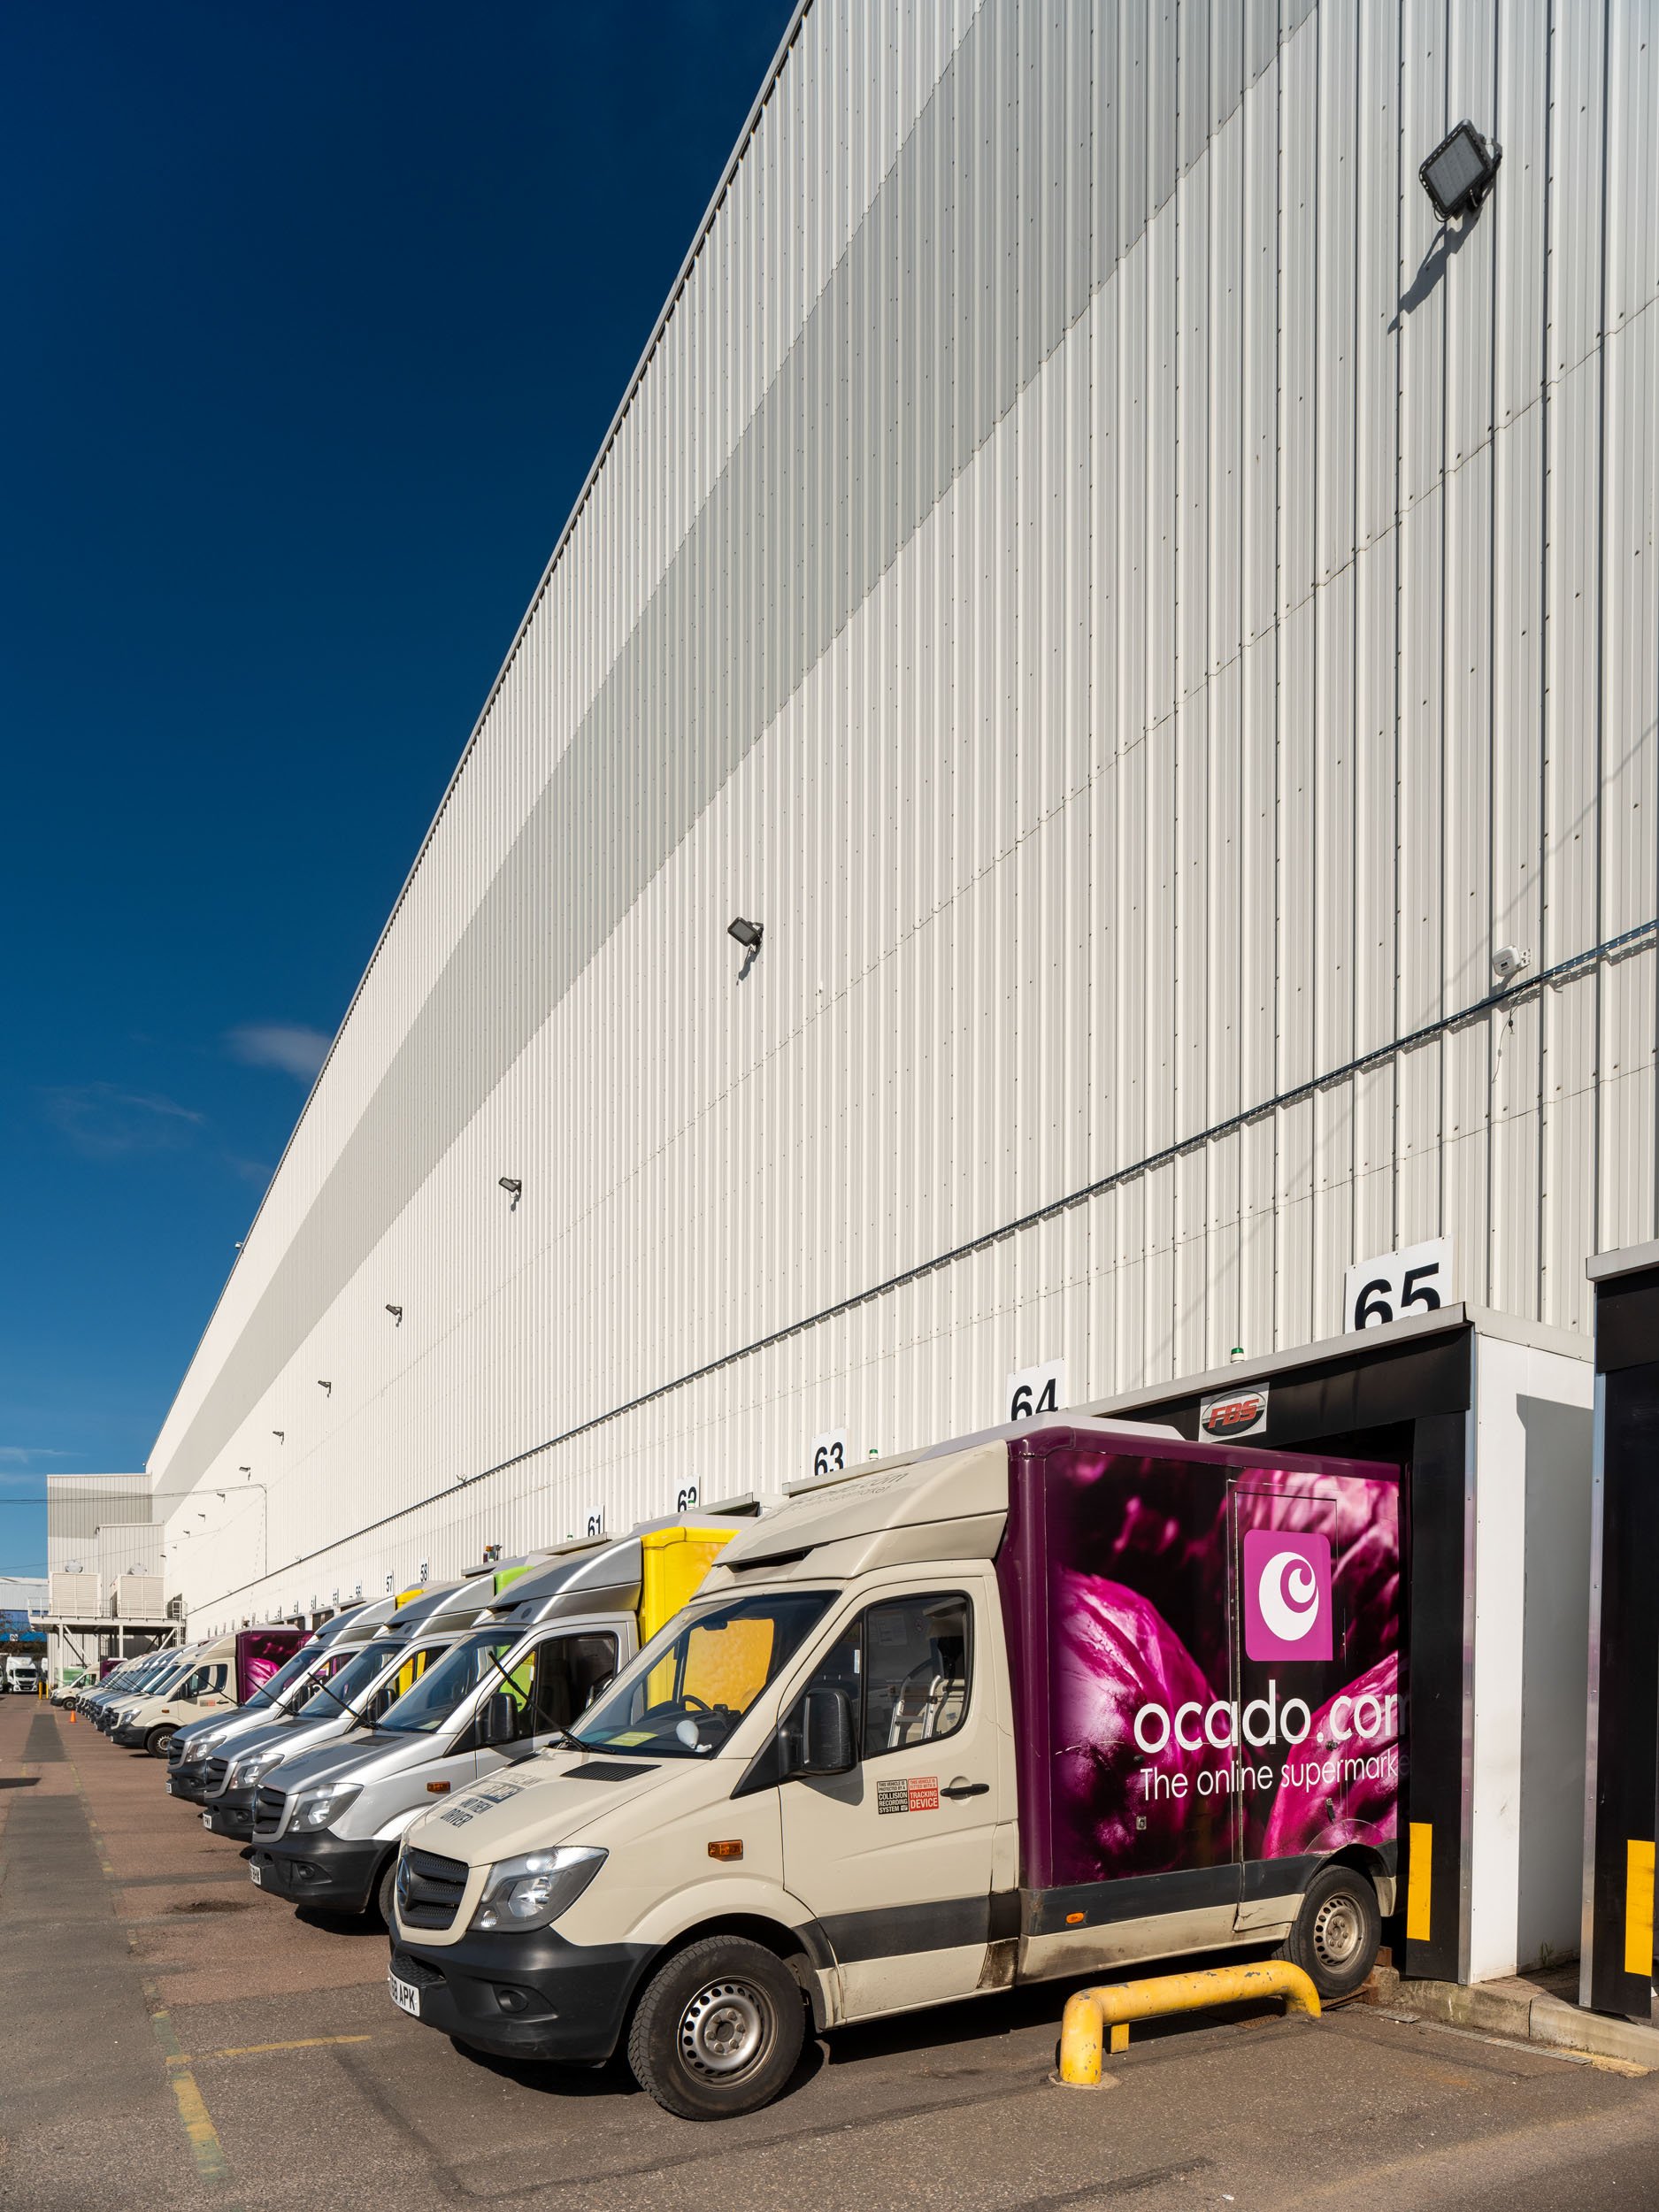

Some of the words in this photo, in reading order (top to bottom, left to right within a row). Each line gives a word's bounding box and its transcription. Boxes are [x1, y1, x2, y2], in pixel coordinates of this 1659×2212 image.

[1354, 1262, 1441, 1331] 65
[1010, 1378, 1059, 1422] 64
[1208, 1398, 1260, 1429] FBS
[813, 1441, 844, 1476] 63
[588, 1514, 601, 1537] 61
[386, 1575, 393, 1593] 57
[419, 1563, 428, 1582] 58
[1140, 1763, 1188, 1801] The
[1196, 1761, 1274, 1795] online
[1280, 1748, 1410, 1793] supermarke
[879, 1792, 908, 1801] COLLISION
[910, 1790, 937, 1799] TRACKING
[910, 1797, 938, 1809] DEVICE
[440, 1808, 473, 1828] DRIVER
[399, 1983, 416, 2011] APK
